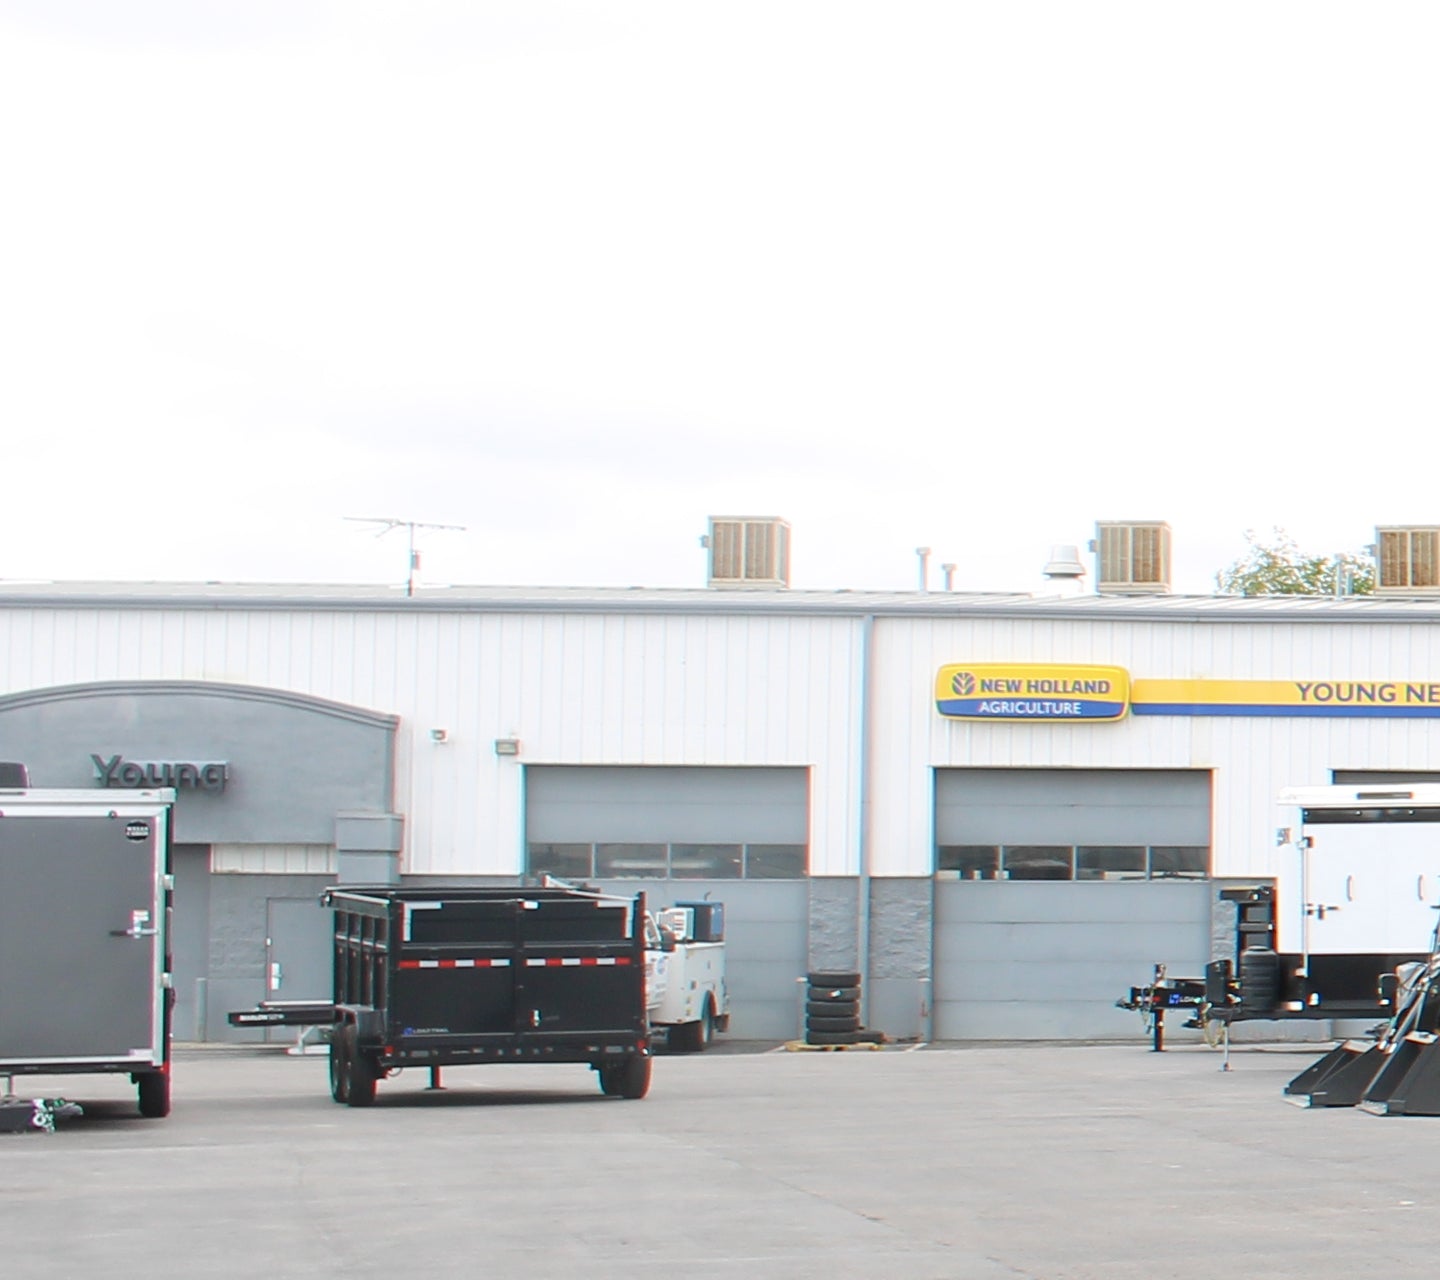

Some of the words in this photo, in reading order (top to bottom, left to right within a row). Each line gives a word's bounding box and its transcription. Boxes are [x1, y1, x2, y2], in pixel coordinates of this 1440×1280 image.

[981, 678, 1022, 693] NEW
[1026, 679, 1111, 694] HOLLAND
[1296, 682, 1397, 703] YOUNG
[979, 700, 1082, 715] AGRICULTURE
[90, 753, 227, 794] Young
